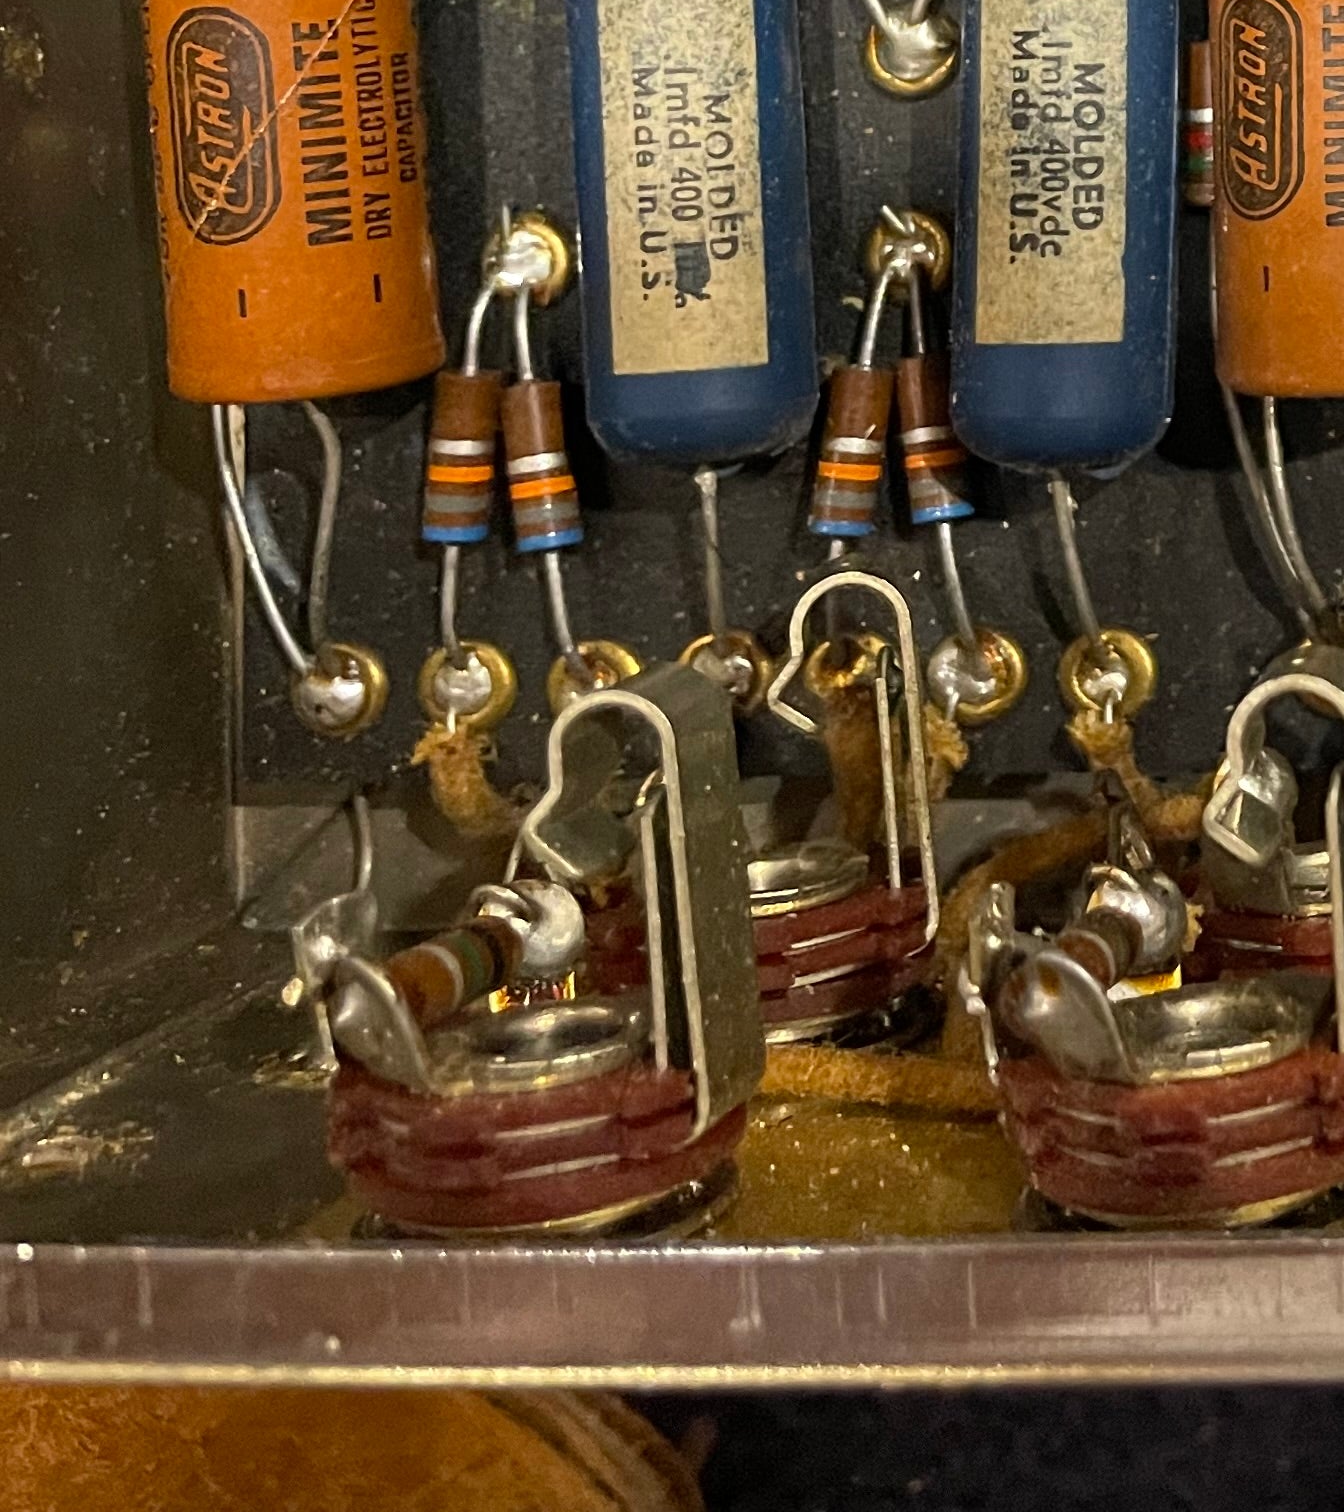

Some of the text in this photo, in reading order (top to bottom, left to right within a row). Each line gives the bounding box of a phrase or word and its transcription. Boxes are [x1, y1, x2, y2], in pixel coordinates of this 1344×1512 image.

[182, 42, 253, 213] ASTRON
[290, 17, 354, 248] MINIMITE
[390, 52, 418, 183] CAPACITOR
[632, 67, 671, 301] Made in U.S.
[701, 93, 740, 260] MOLDED
[1009, 30, 1040, 264] Made in U.S.
[1072, 63, 1105, 229] MOLDED
[1228, 19, 1284, 189] ASTRON
[361, 192, 393, 239] DRY
[670, 167, 701, 221] 400
[1039, 138, 1071, 258] 400vdc
